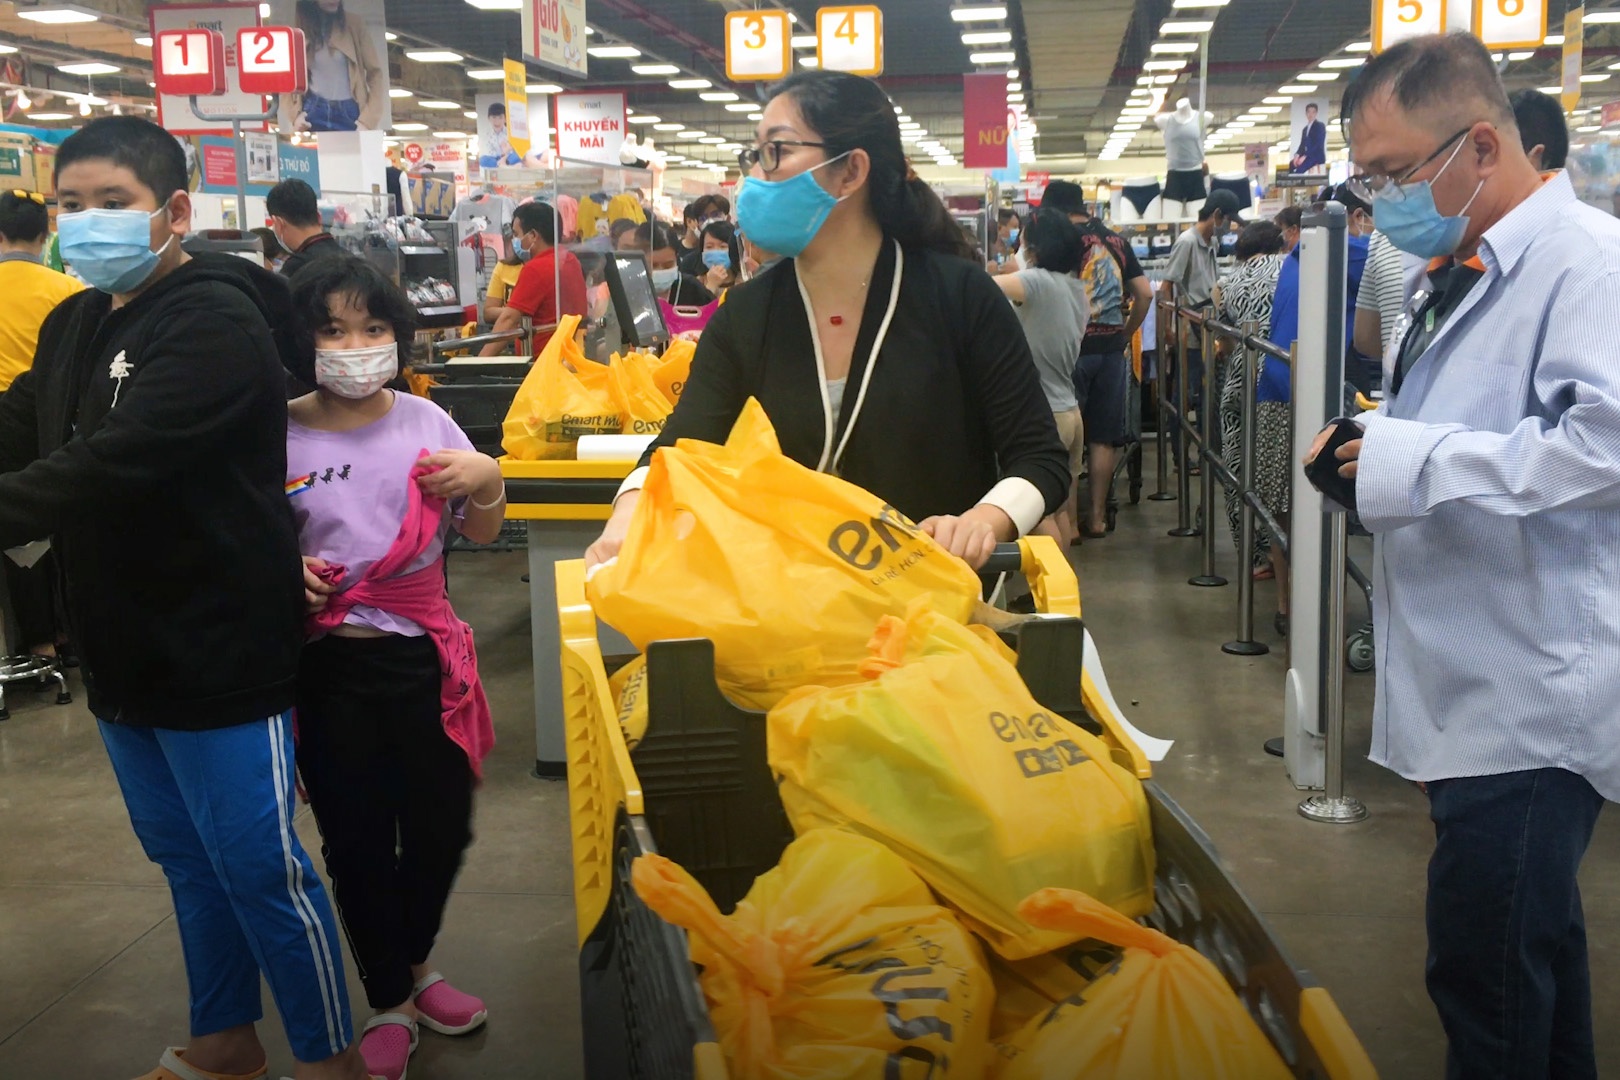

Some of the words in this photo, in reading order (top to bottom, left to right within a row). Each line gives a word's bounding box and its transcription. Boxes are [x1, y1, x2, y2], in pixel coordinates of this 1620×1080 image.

[1397, 0, 1423, 22] 5
[743, 15, 767, 49] 3
[834, 11, 859, 45] 4
[174, 33, 189, 66] 1
[253, 31, 275, 64] 2
[564, 116, 619, 132] KHUYẾN
[561, 413, 602, 426] emart
